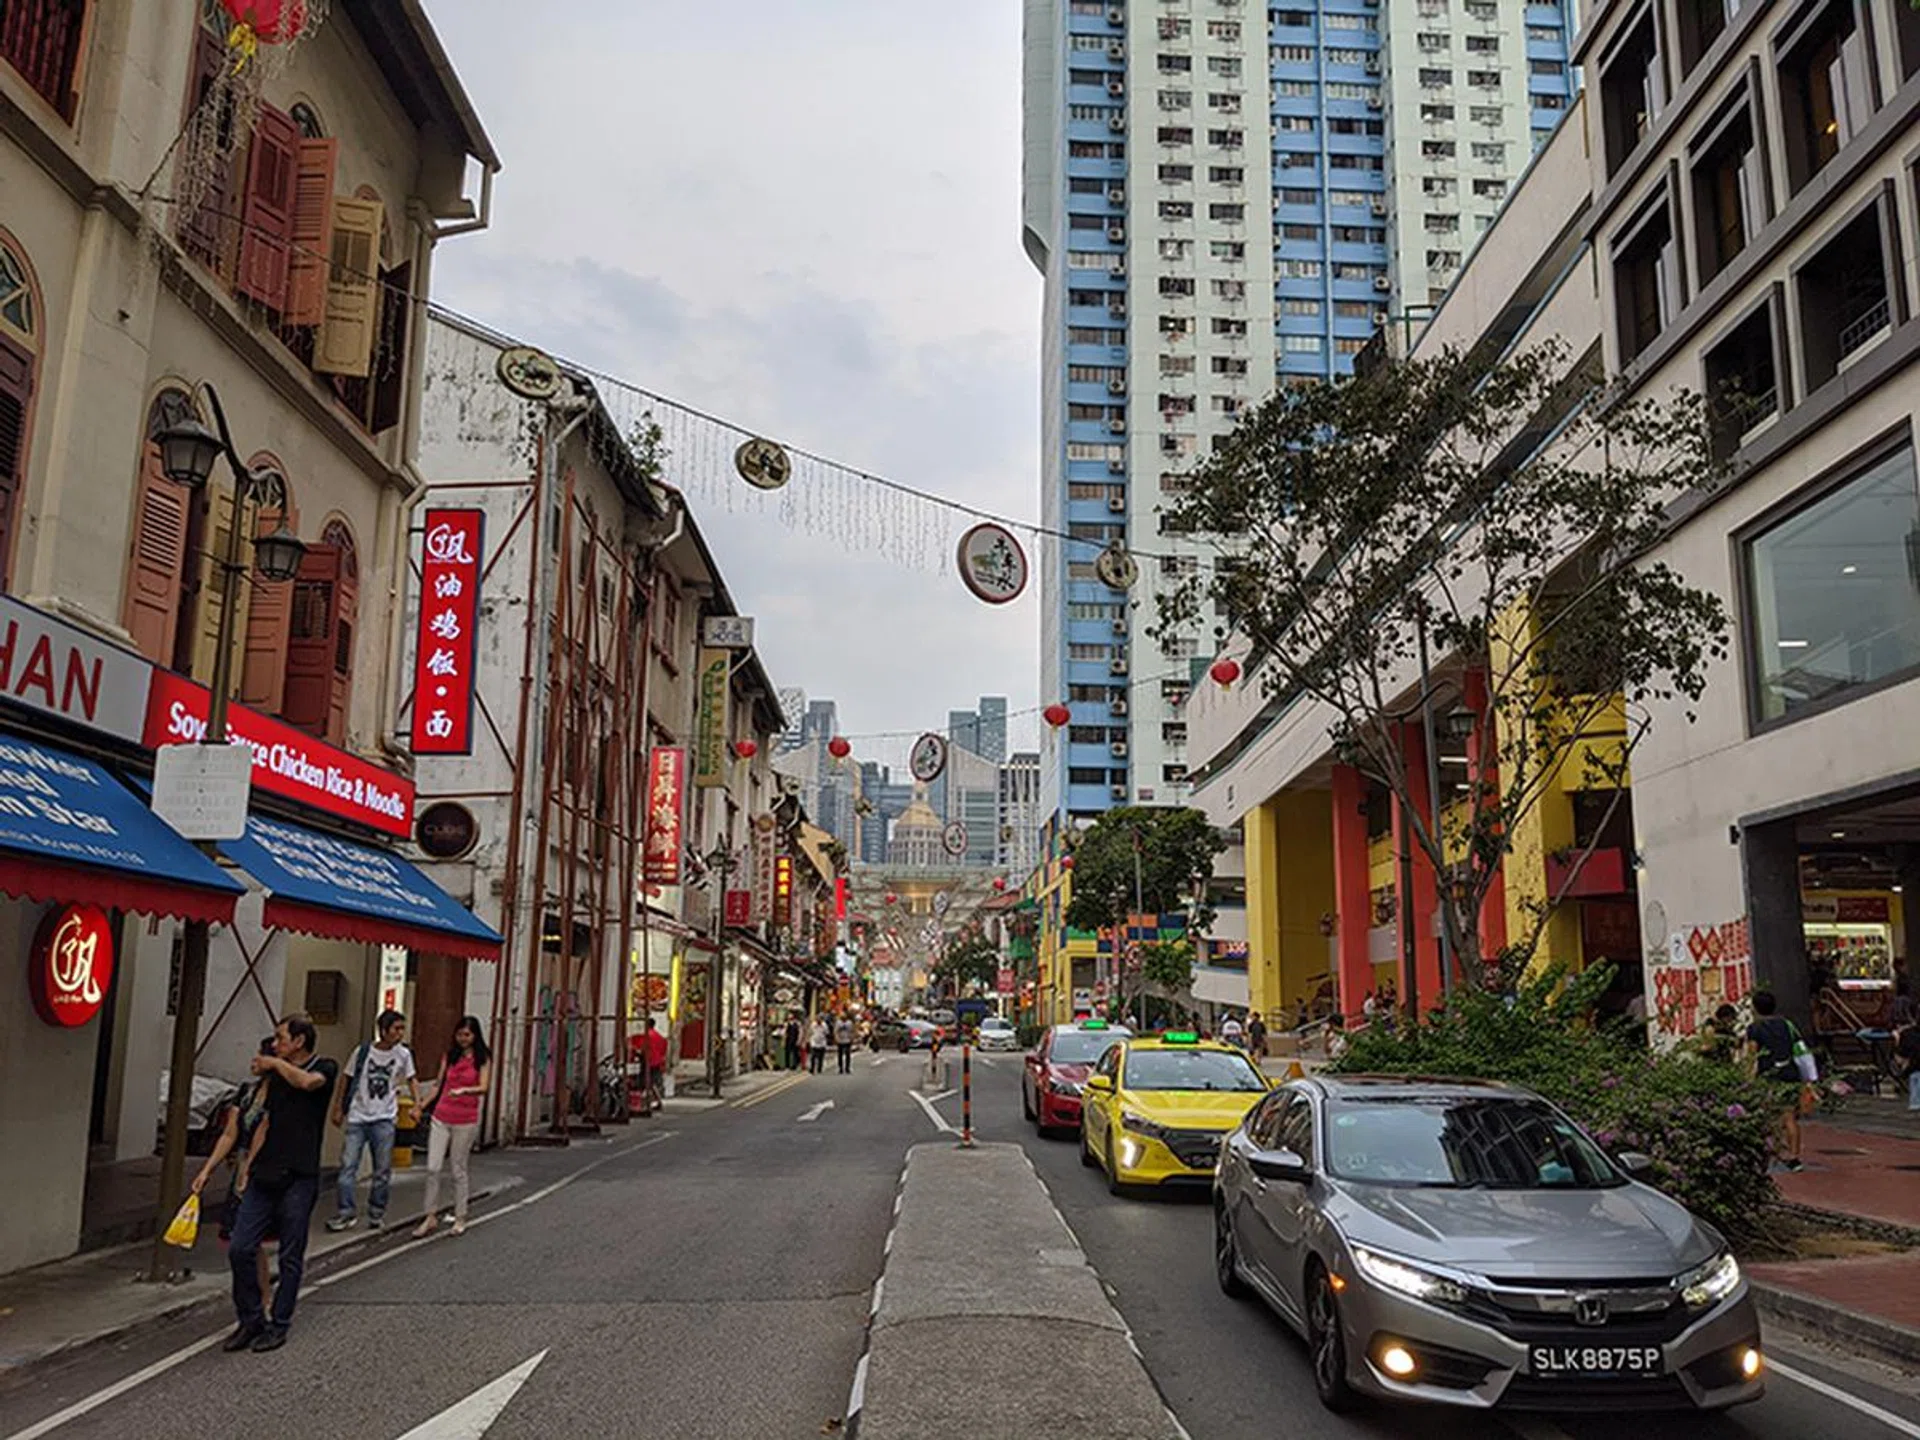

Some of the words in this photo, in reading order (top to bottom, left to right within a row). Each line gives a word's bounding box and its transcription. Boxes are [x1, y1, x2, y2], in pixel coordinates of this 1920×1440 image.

[269, 744, 325, 790] Chicken
[326, 766, 352, 800] Rice
[350, 779, 363, 801] &
[364, 783, 407, 821] Noodle
[26, 795, 119, 836] Star
[1533, 1348, 1660, 1370] SLK8875P
